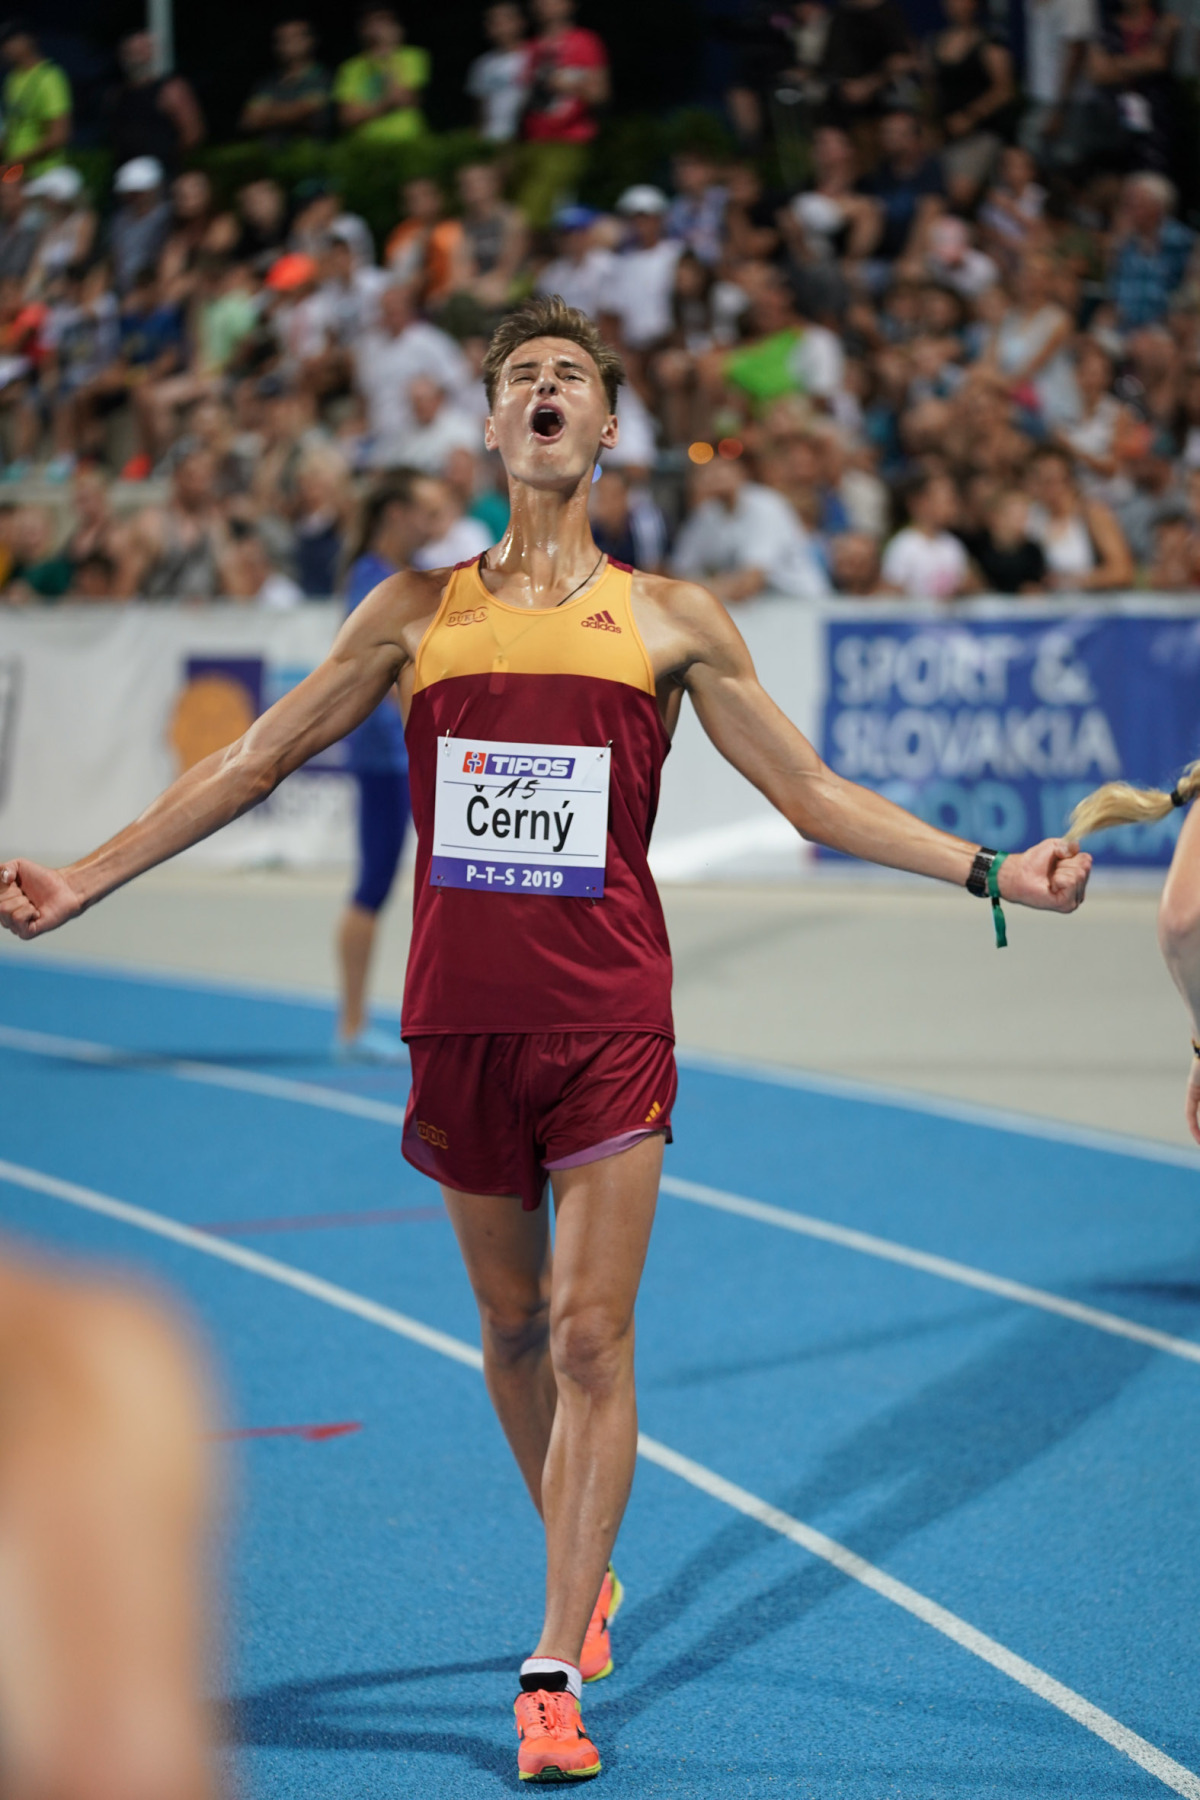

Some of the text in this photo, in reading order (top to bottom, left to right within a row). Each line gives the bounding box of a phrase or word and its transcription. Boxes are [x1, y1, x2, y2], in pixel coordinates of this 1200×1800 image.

[580, 620, 622, 634] adidas
[834, 633, 1095, 704] SPORT &
[832, 705, 1122, 779] SLOVAKIA
[491, 756, 570, 777] TIPOS
[495, 777, 541, 799] 15
[466, 784, 575, 853] Černý
[521, 869, 564, 889] 2019
